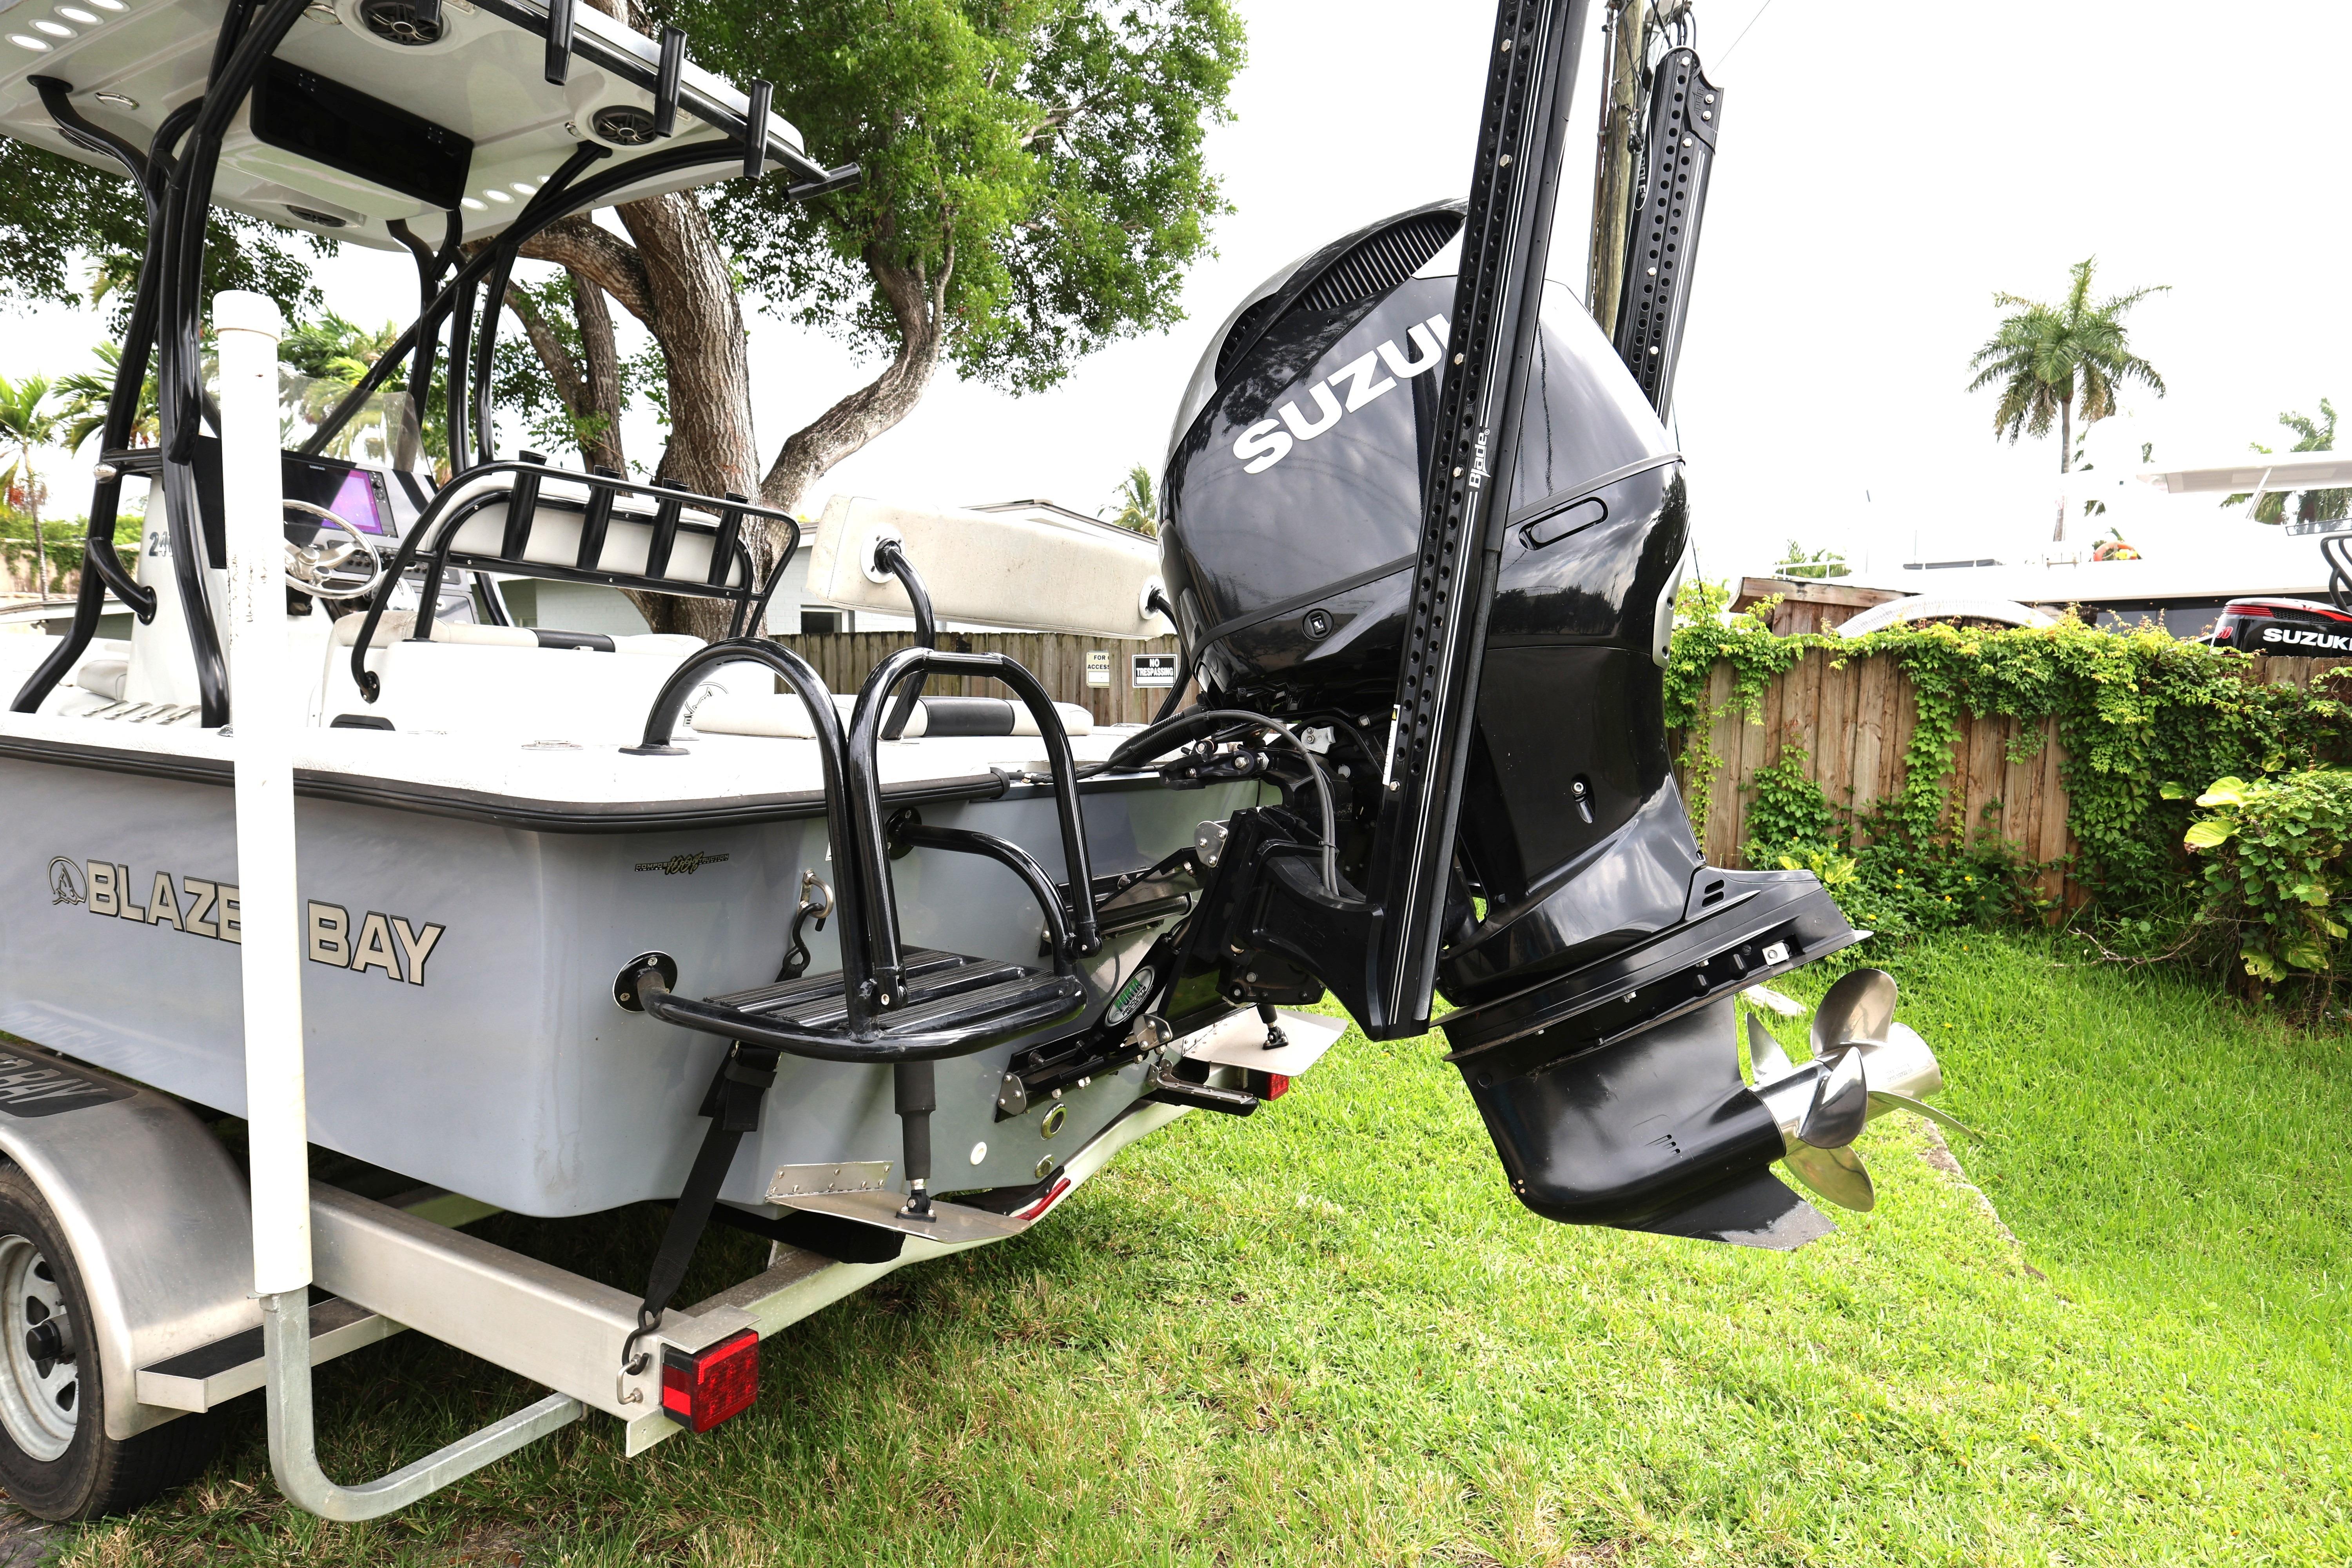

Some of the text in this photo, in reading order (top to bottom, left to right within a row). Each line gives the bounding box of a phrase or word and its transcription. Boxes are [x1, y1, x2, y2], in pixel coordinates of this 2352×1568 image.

[1136, 667, 1174, 677] TRESPASSING
[1149, 659, 1160, 668] NO
[87, 859, 446, 986] BLAZE BAY
[1114, 976, 1143, 1013] PORTA
[1122, 985, 1147, 1016] PRODUCTS
